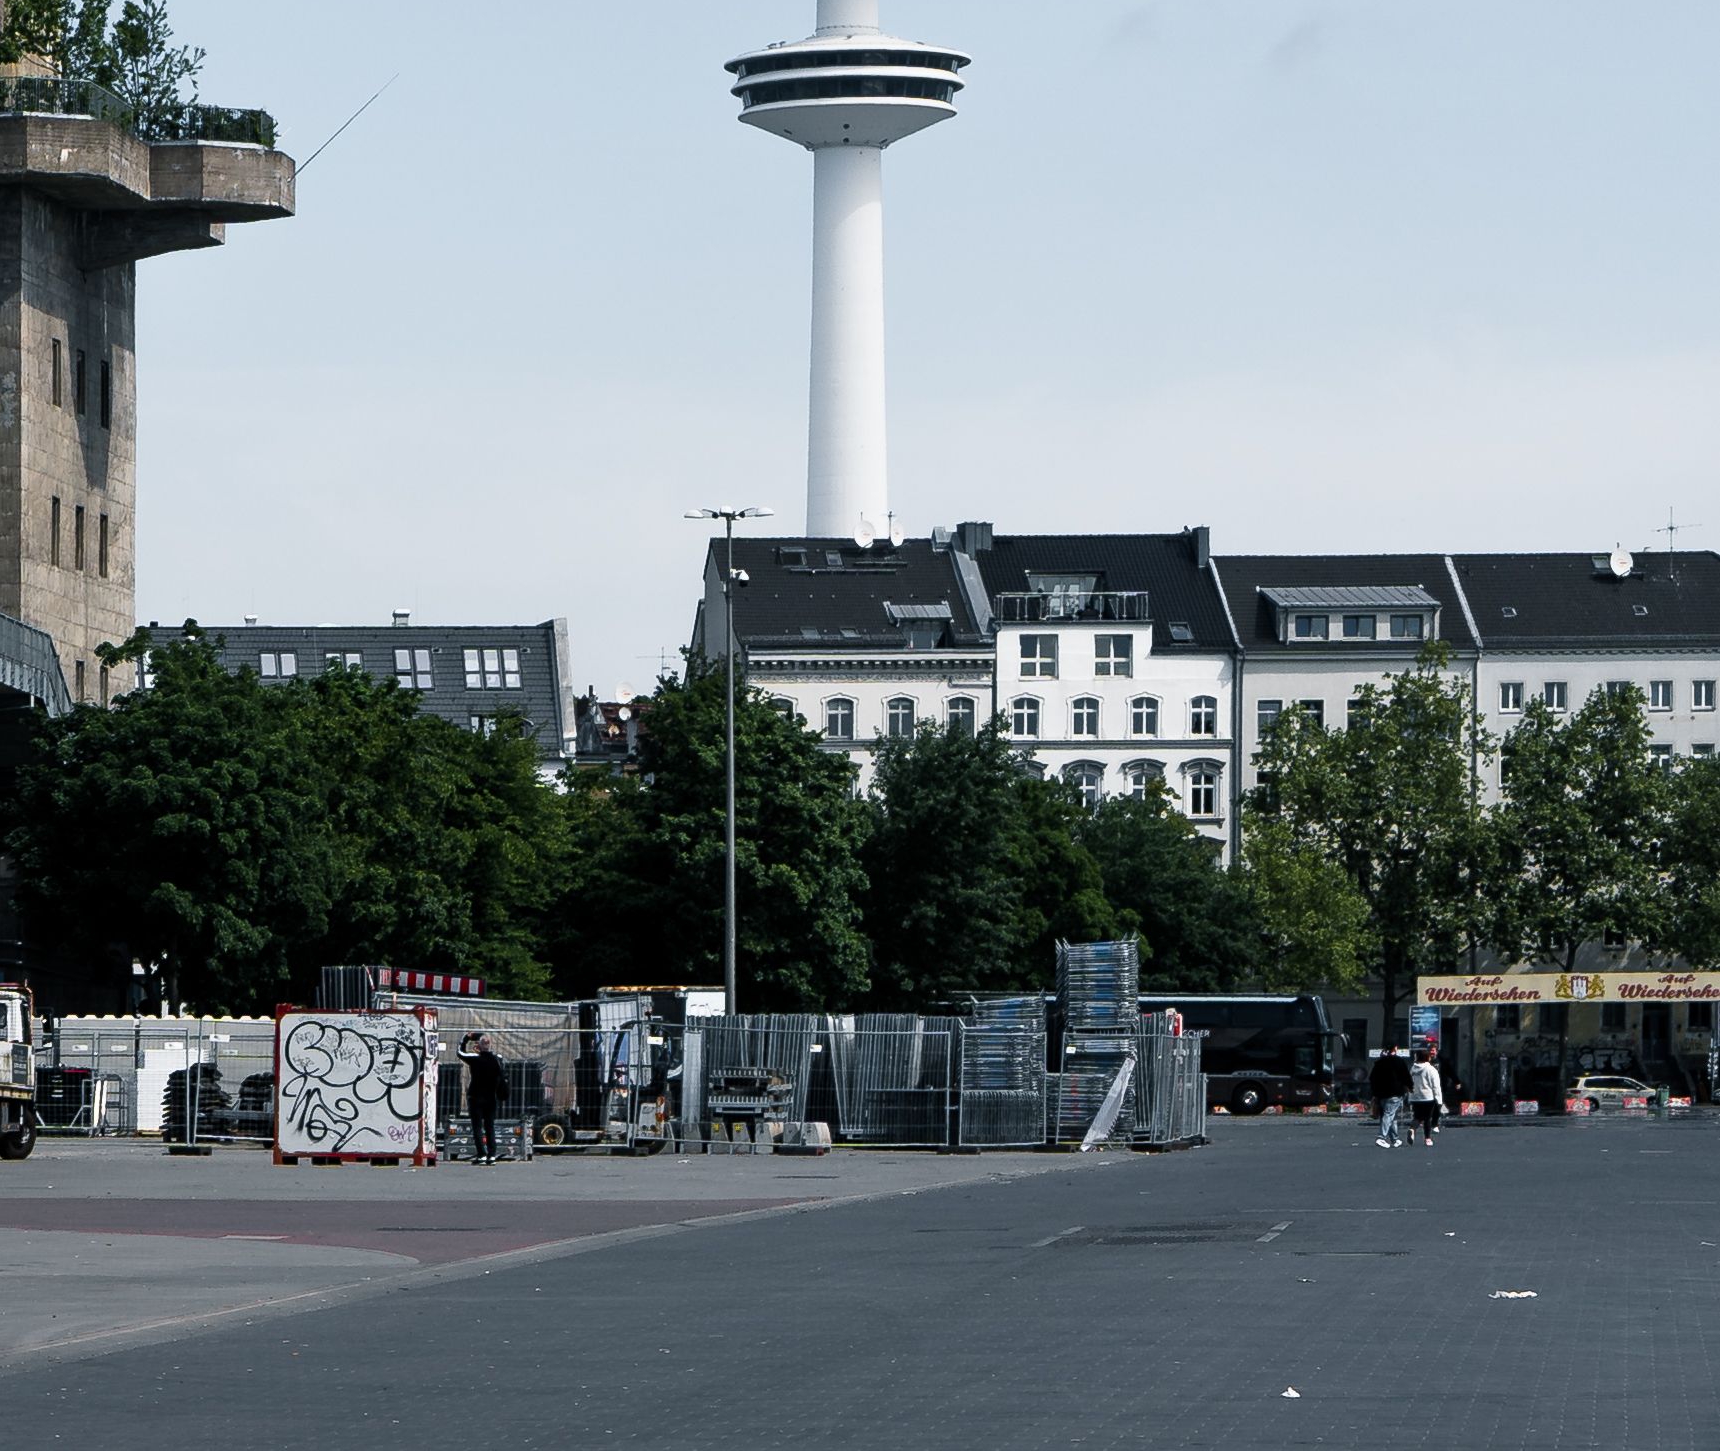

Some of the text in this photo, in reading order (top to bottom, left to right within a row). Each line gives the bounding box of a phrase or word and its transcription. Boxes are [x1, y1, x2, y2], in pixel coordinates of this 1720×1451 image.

[1465, 976, 1503, 986] Auf
[1658, 974, 1696, 984] Auf
[1425, 986, 1541, 1002] Wiedersehen
